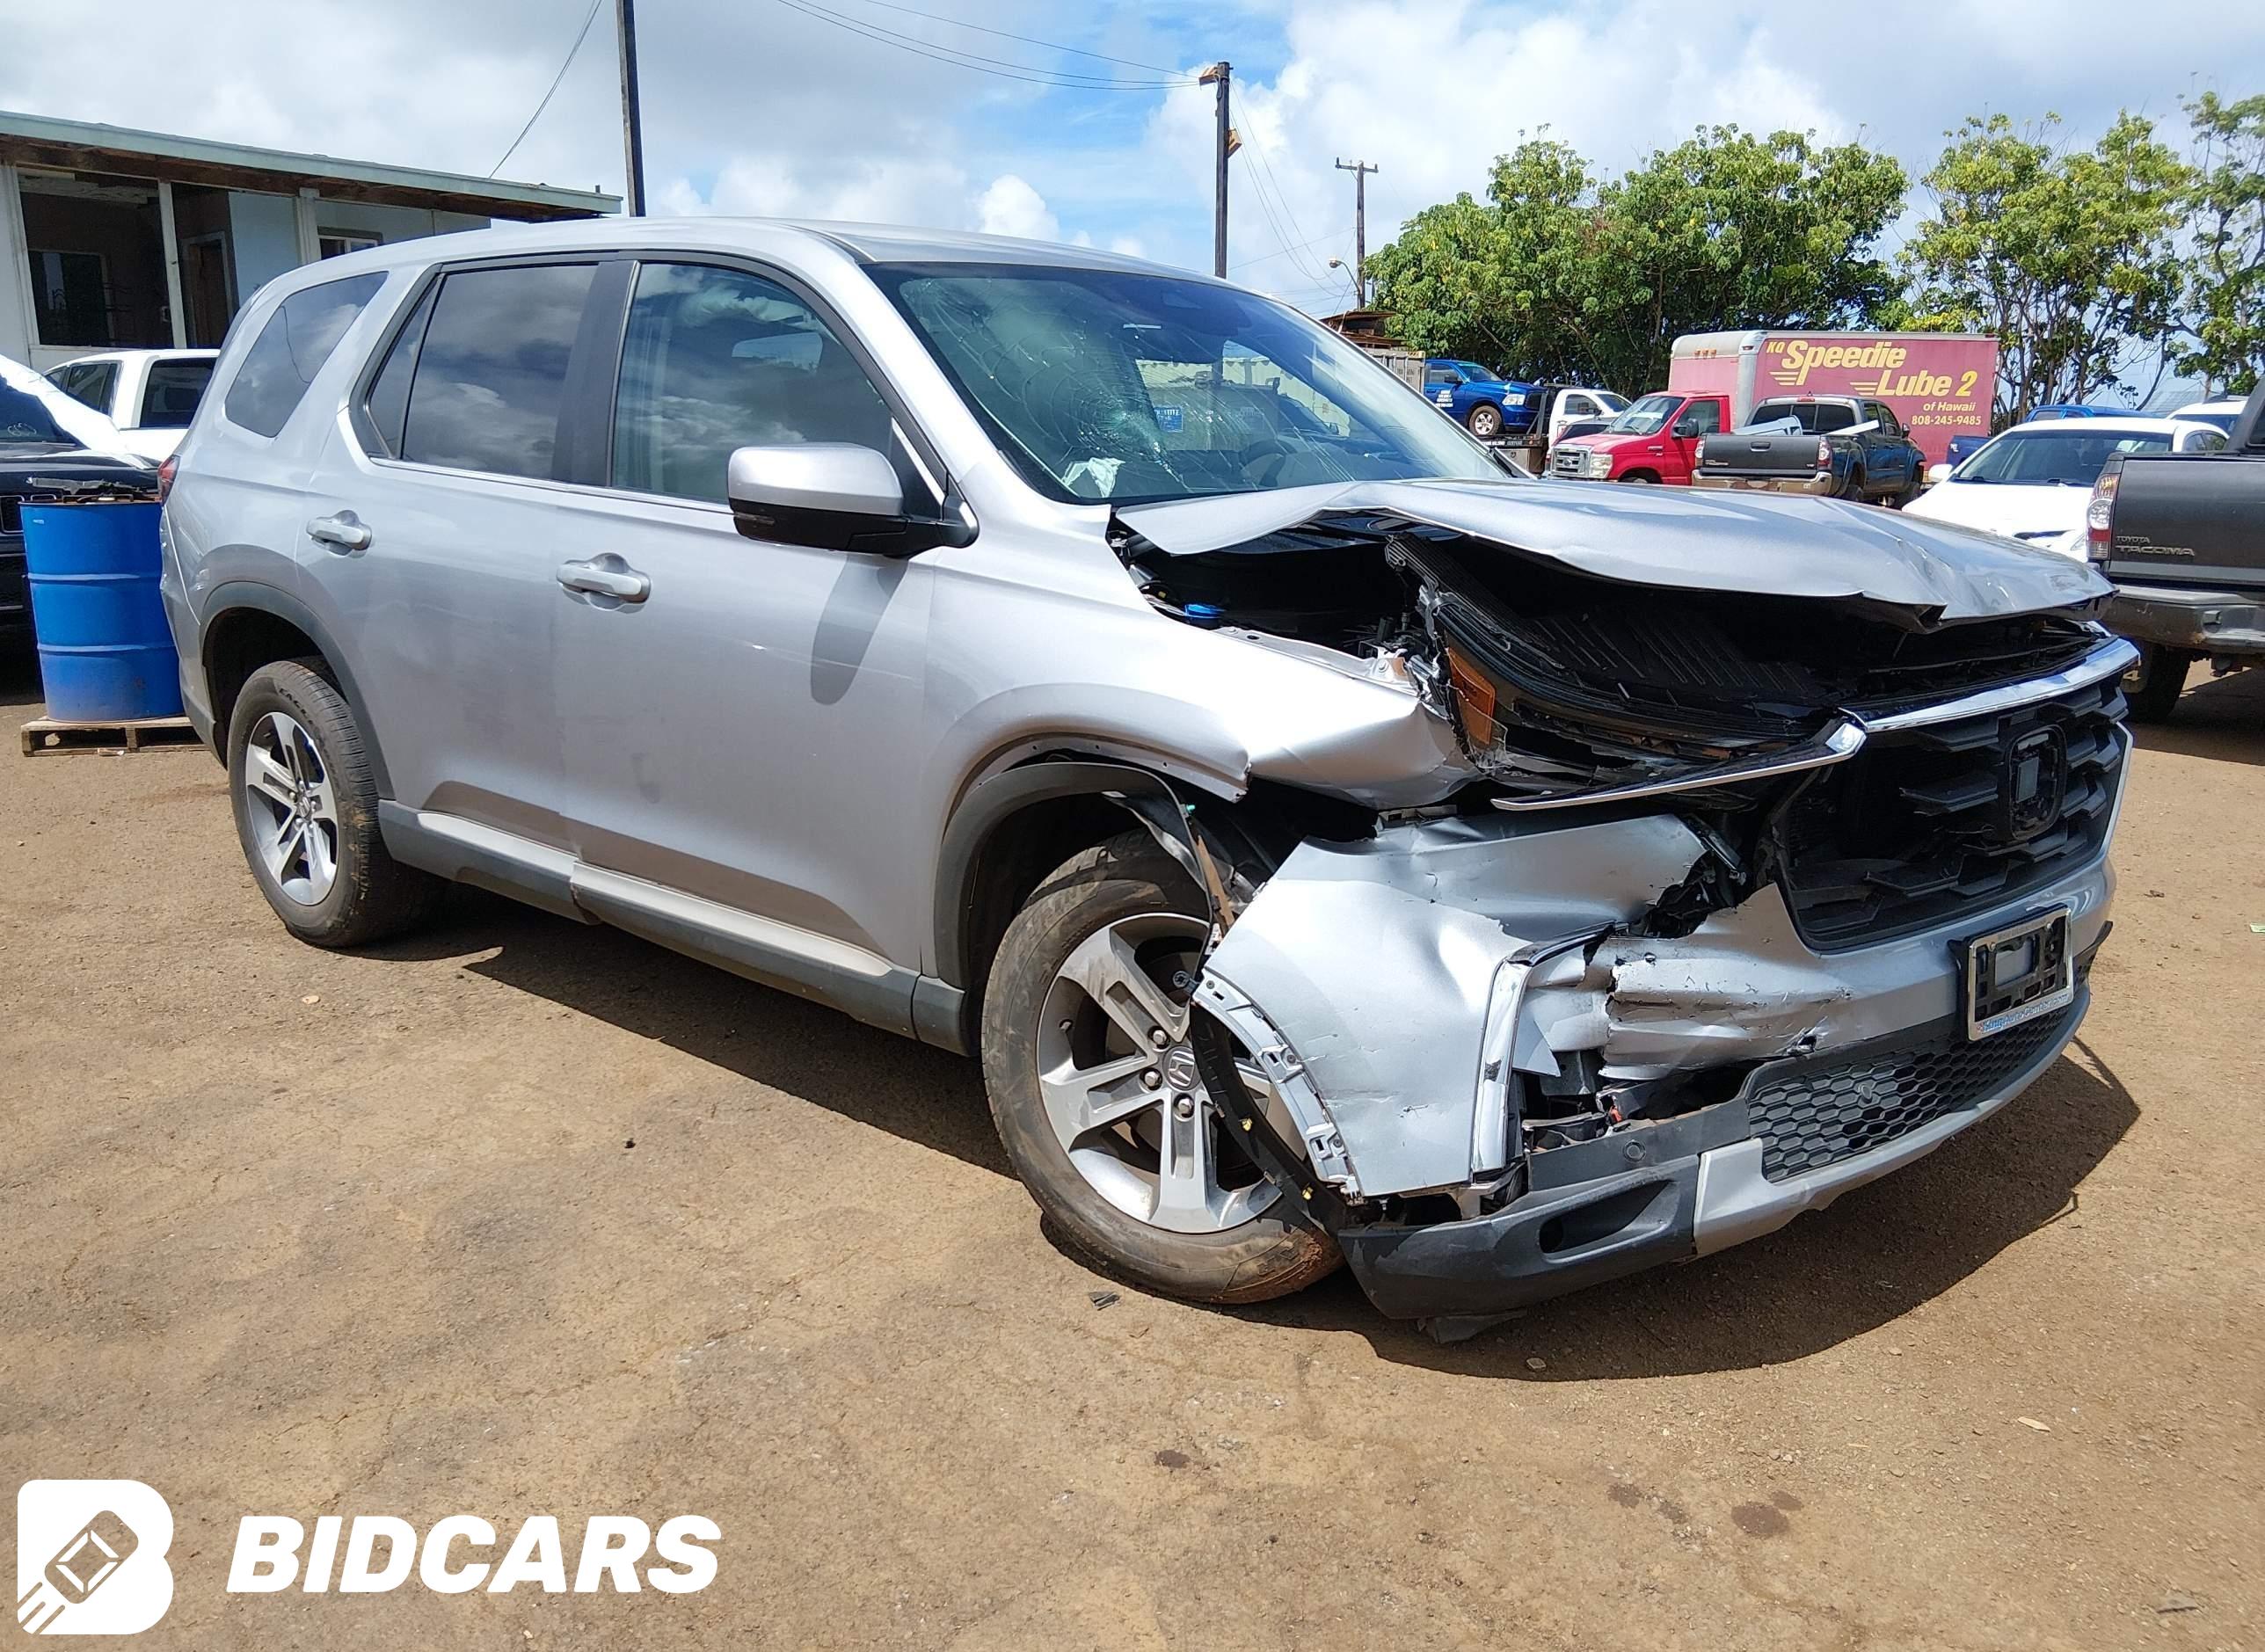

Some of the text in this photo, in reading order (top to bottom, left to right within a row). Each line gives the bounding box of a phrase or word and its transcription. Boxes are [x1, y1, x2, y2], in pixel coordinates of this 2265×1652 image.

[1781, 340, 1907, 386] Speedie
[1875, 370, 1978, 397] Lube 2
[1923, 402, 1977, 411] of Hawaii
[1912, 415, 1982, 426] 808-245-9485
[2116, 535, 2151, 544] TOYOTA
[2115, 545, 2196, 557] TACOMA
